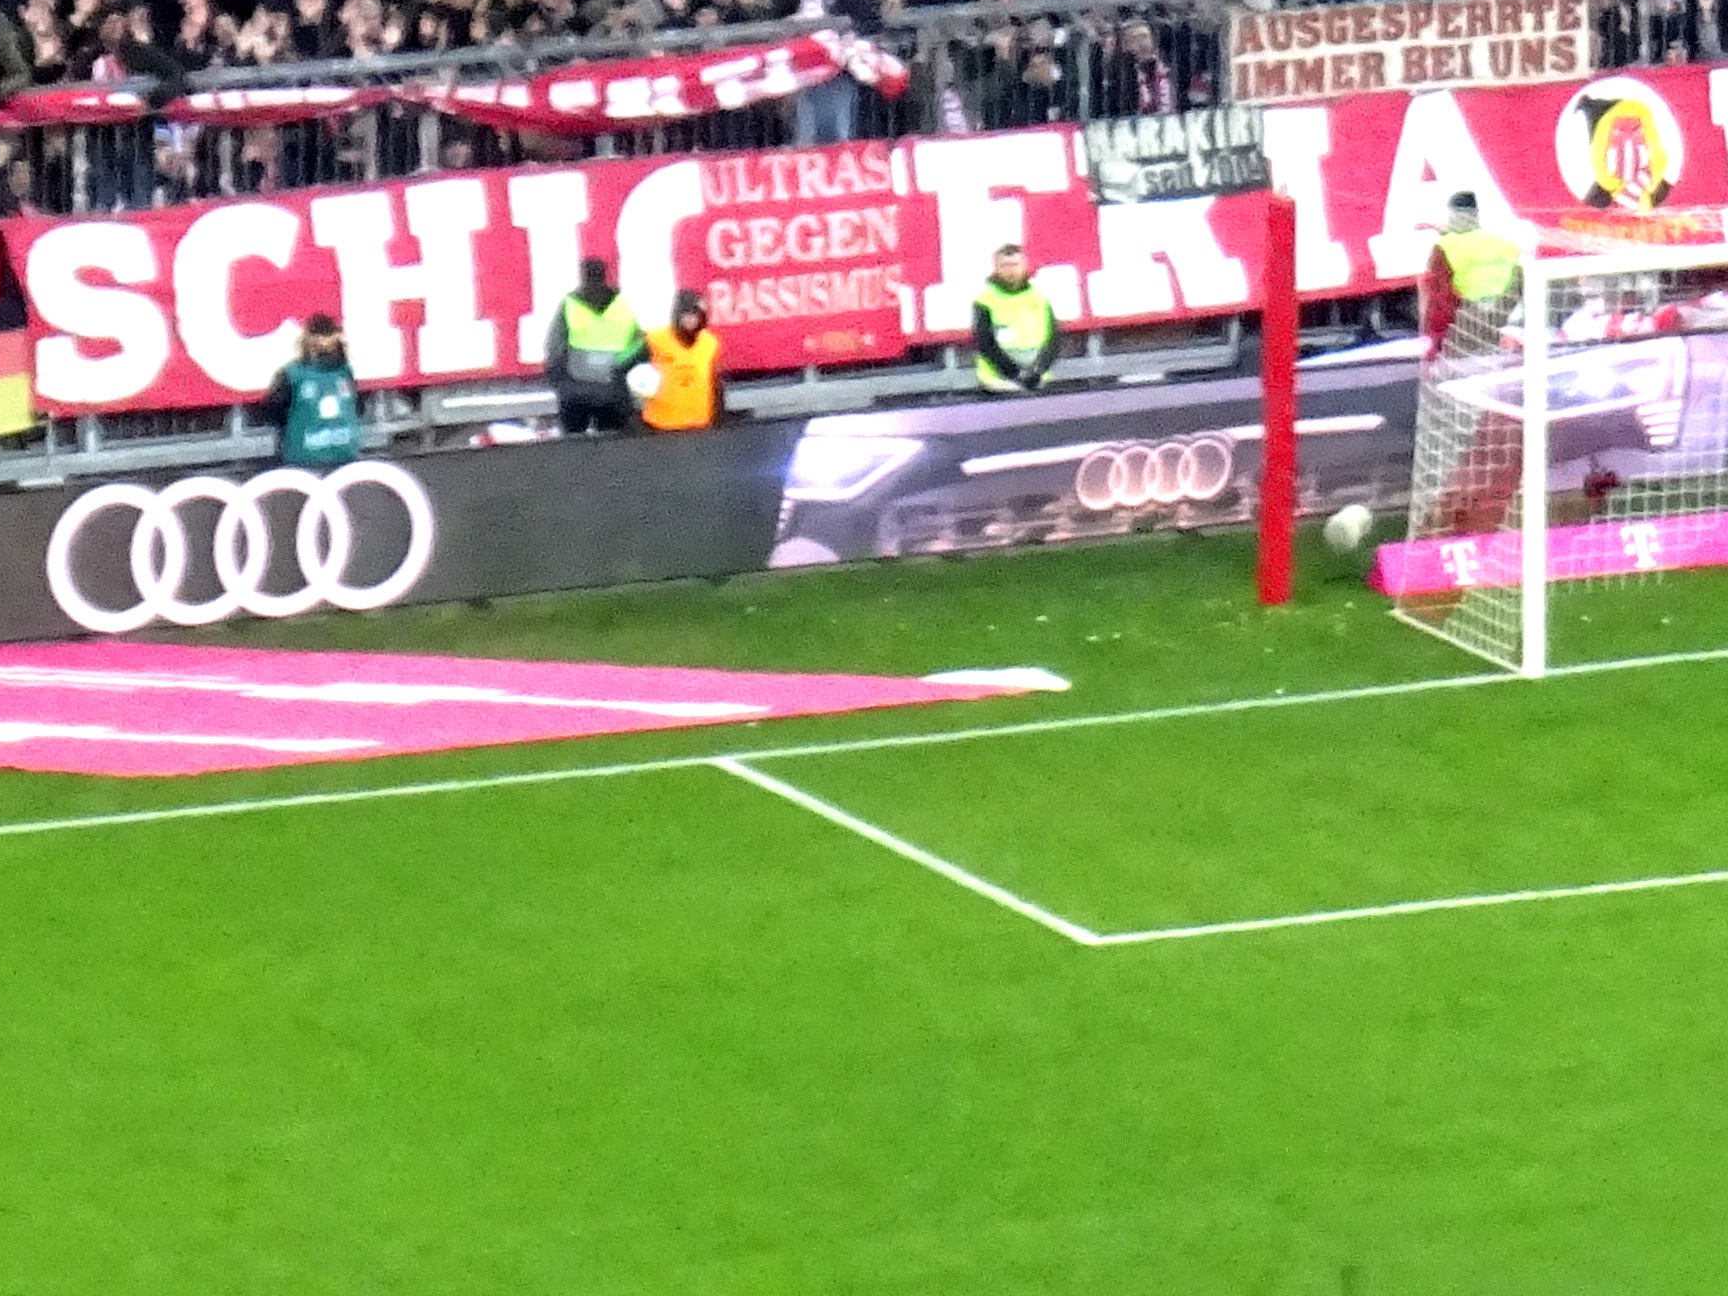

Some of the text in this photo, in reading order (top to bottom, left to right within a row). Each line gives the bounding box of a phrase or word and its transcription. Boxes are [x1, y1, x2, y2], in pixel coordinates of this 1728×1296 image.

[1234, 35, 1578, 100] IMMER BEI UNS
[700, 142, 892, 207] ULTRAS
[707, 204, 900, 268] GEGEN
[708, 264, 903, 326] RASSISMUS
